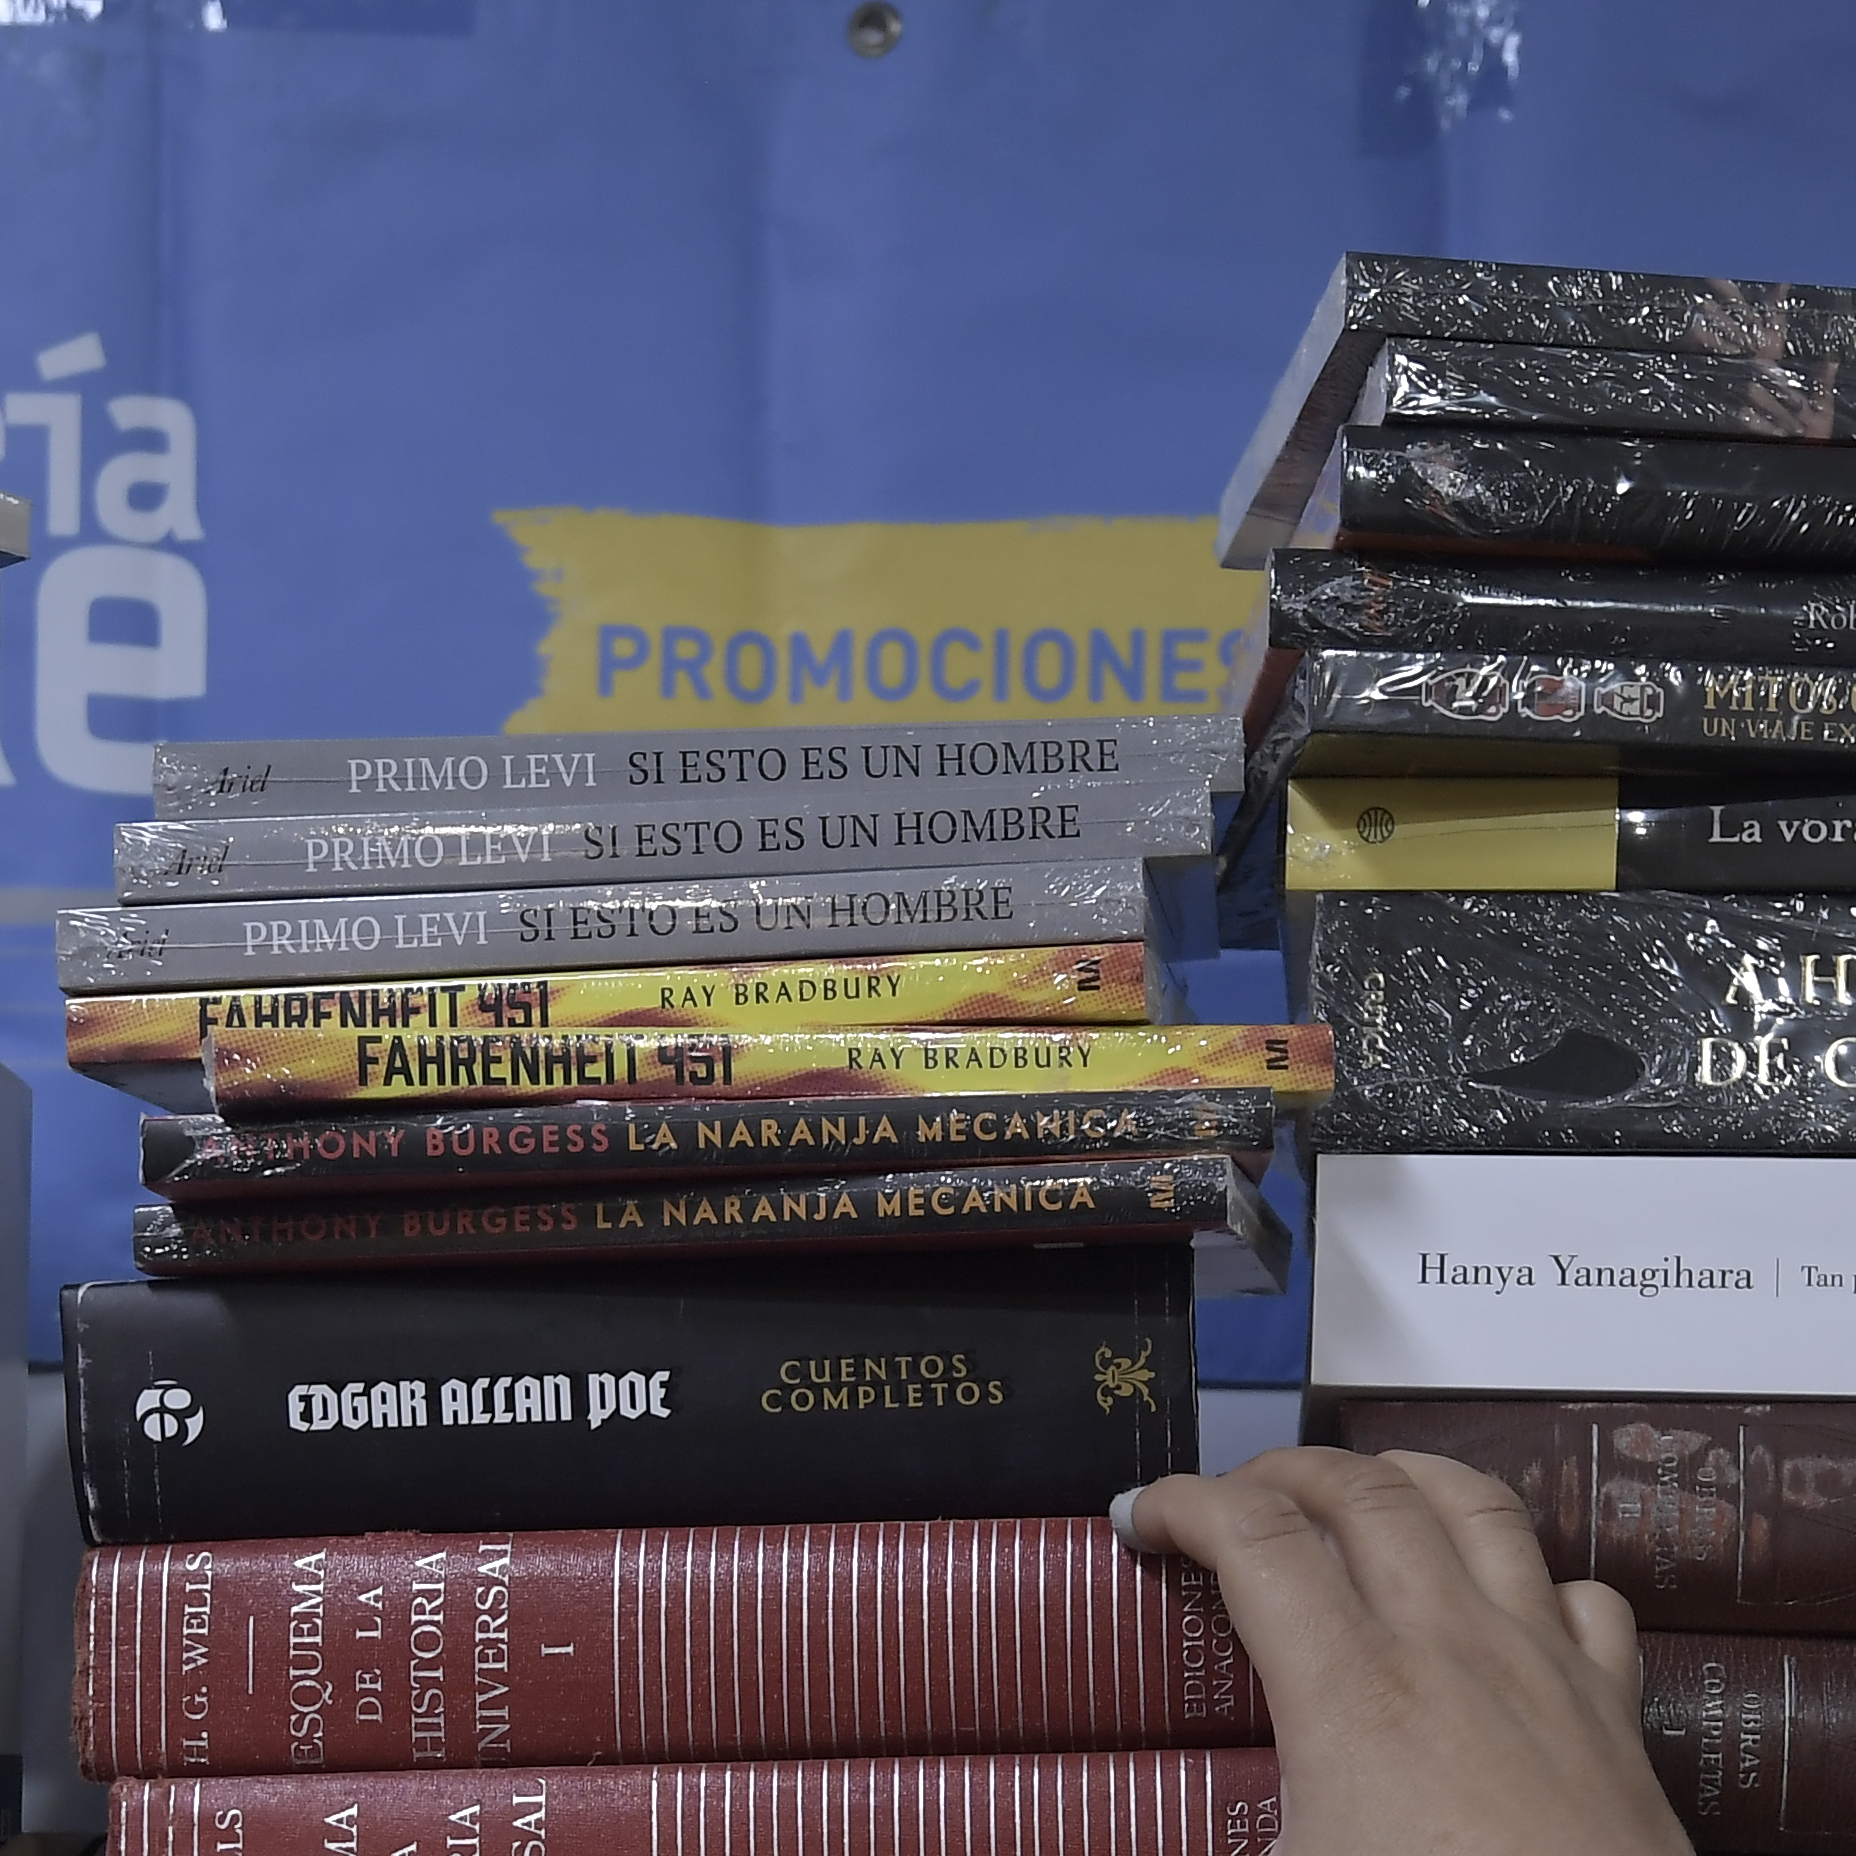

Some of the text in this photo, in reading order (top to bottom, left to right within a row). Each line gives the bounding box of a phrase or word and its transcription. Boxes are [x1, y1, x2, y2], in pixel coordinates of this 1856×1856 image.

[348, 737, 1120, 795] PRIMO LEVI SI ESTO ES UN HOMBRE
[1708, 805, 1763, 843] La
[357, 1037, 1095, 1088] FAHRENHEIT 451 RAY BRADBURY
[596, 1199, 645, 1231] LA
[662, 1191, 858, 1228] NARANJA
[1416, 1251, 1536, 1295] Hanya
[1548, 1253, 1755, 1298] Yanagihara
[1800, 1264, 1845, 1288] Tan
[778, 1354, 969, 1386] CUENTOS
[286, 1370, 672, 1432] EDGAR ALLAN POE
[761, 1380, 1006, 1413] COMPLETOS
